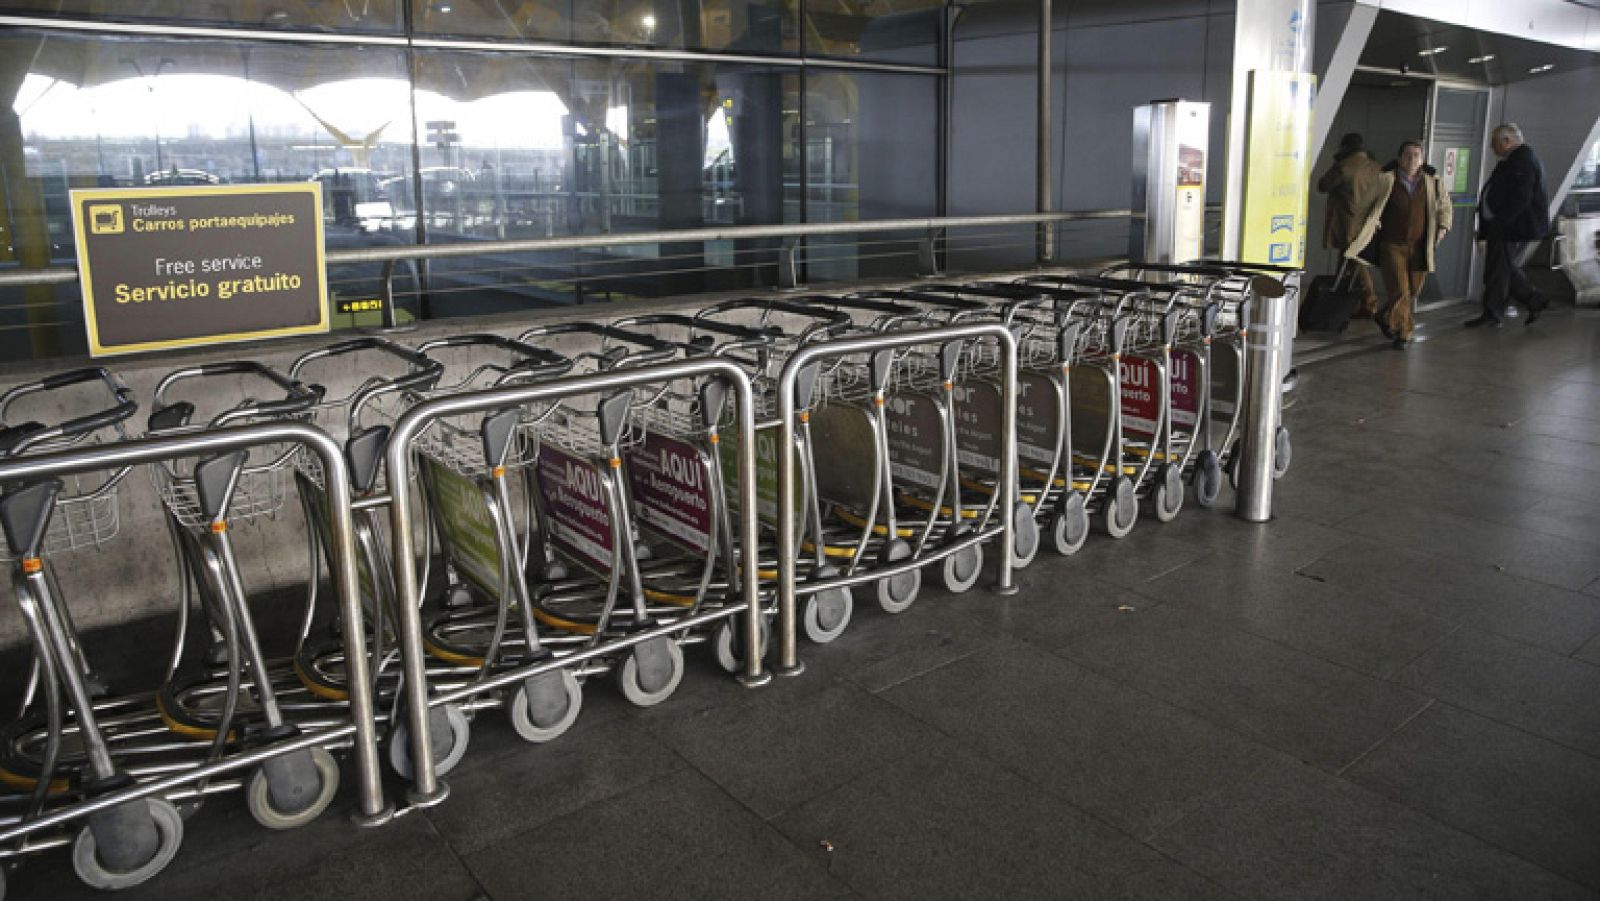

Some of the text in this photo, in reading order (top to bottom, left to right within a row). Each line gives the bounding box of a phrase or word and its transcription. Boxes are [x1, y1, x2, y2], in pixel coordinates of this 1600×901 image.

[130, 203, 178, 217] Trolleys
[132, 213, 295, 232] Carros portaequipajes
[155, 254, 263, 276] Free service
[114, 272, 301, 304] Servicio gratuito
